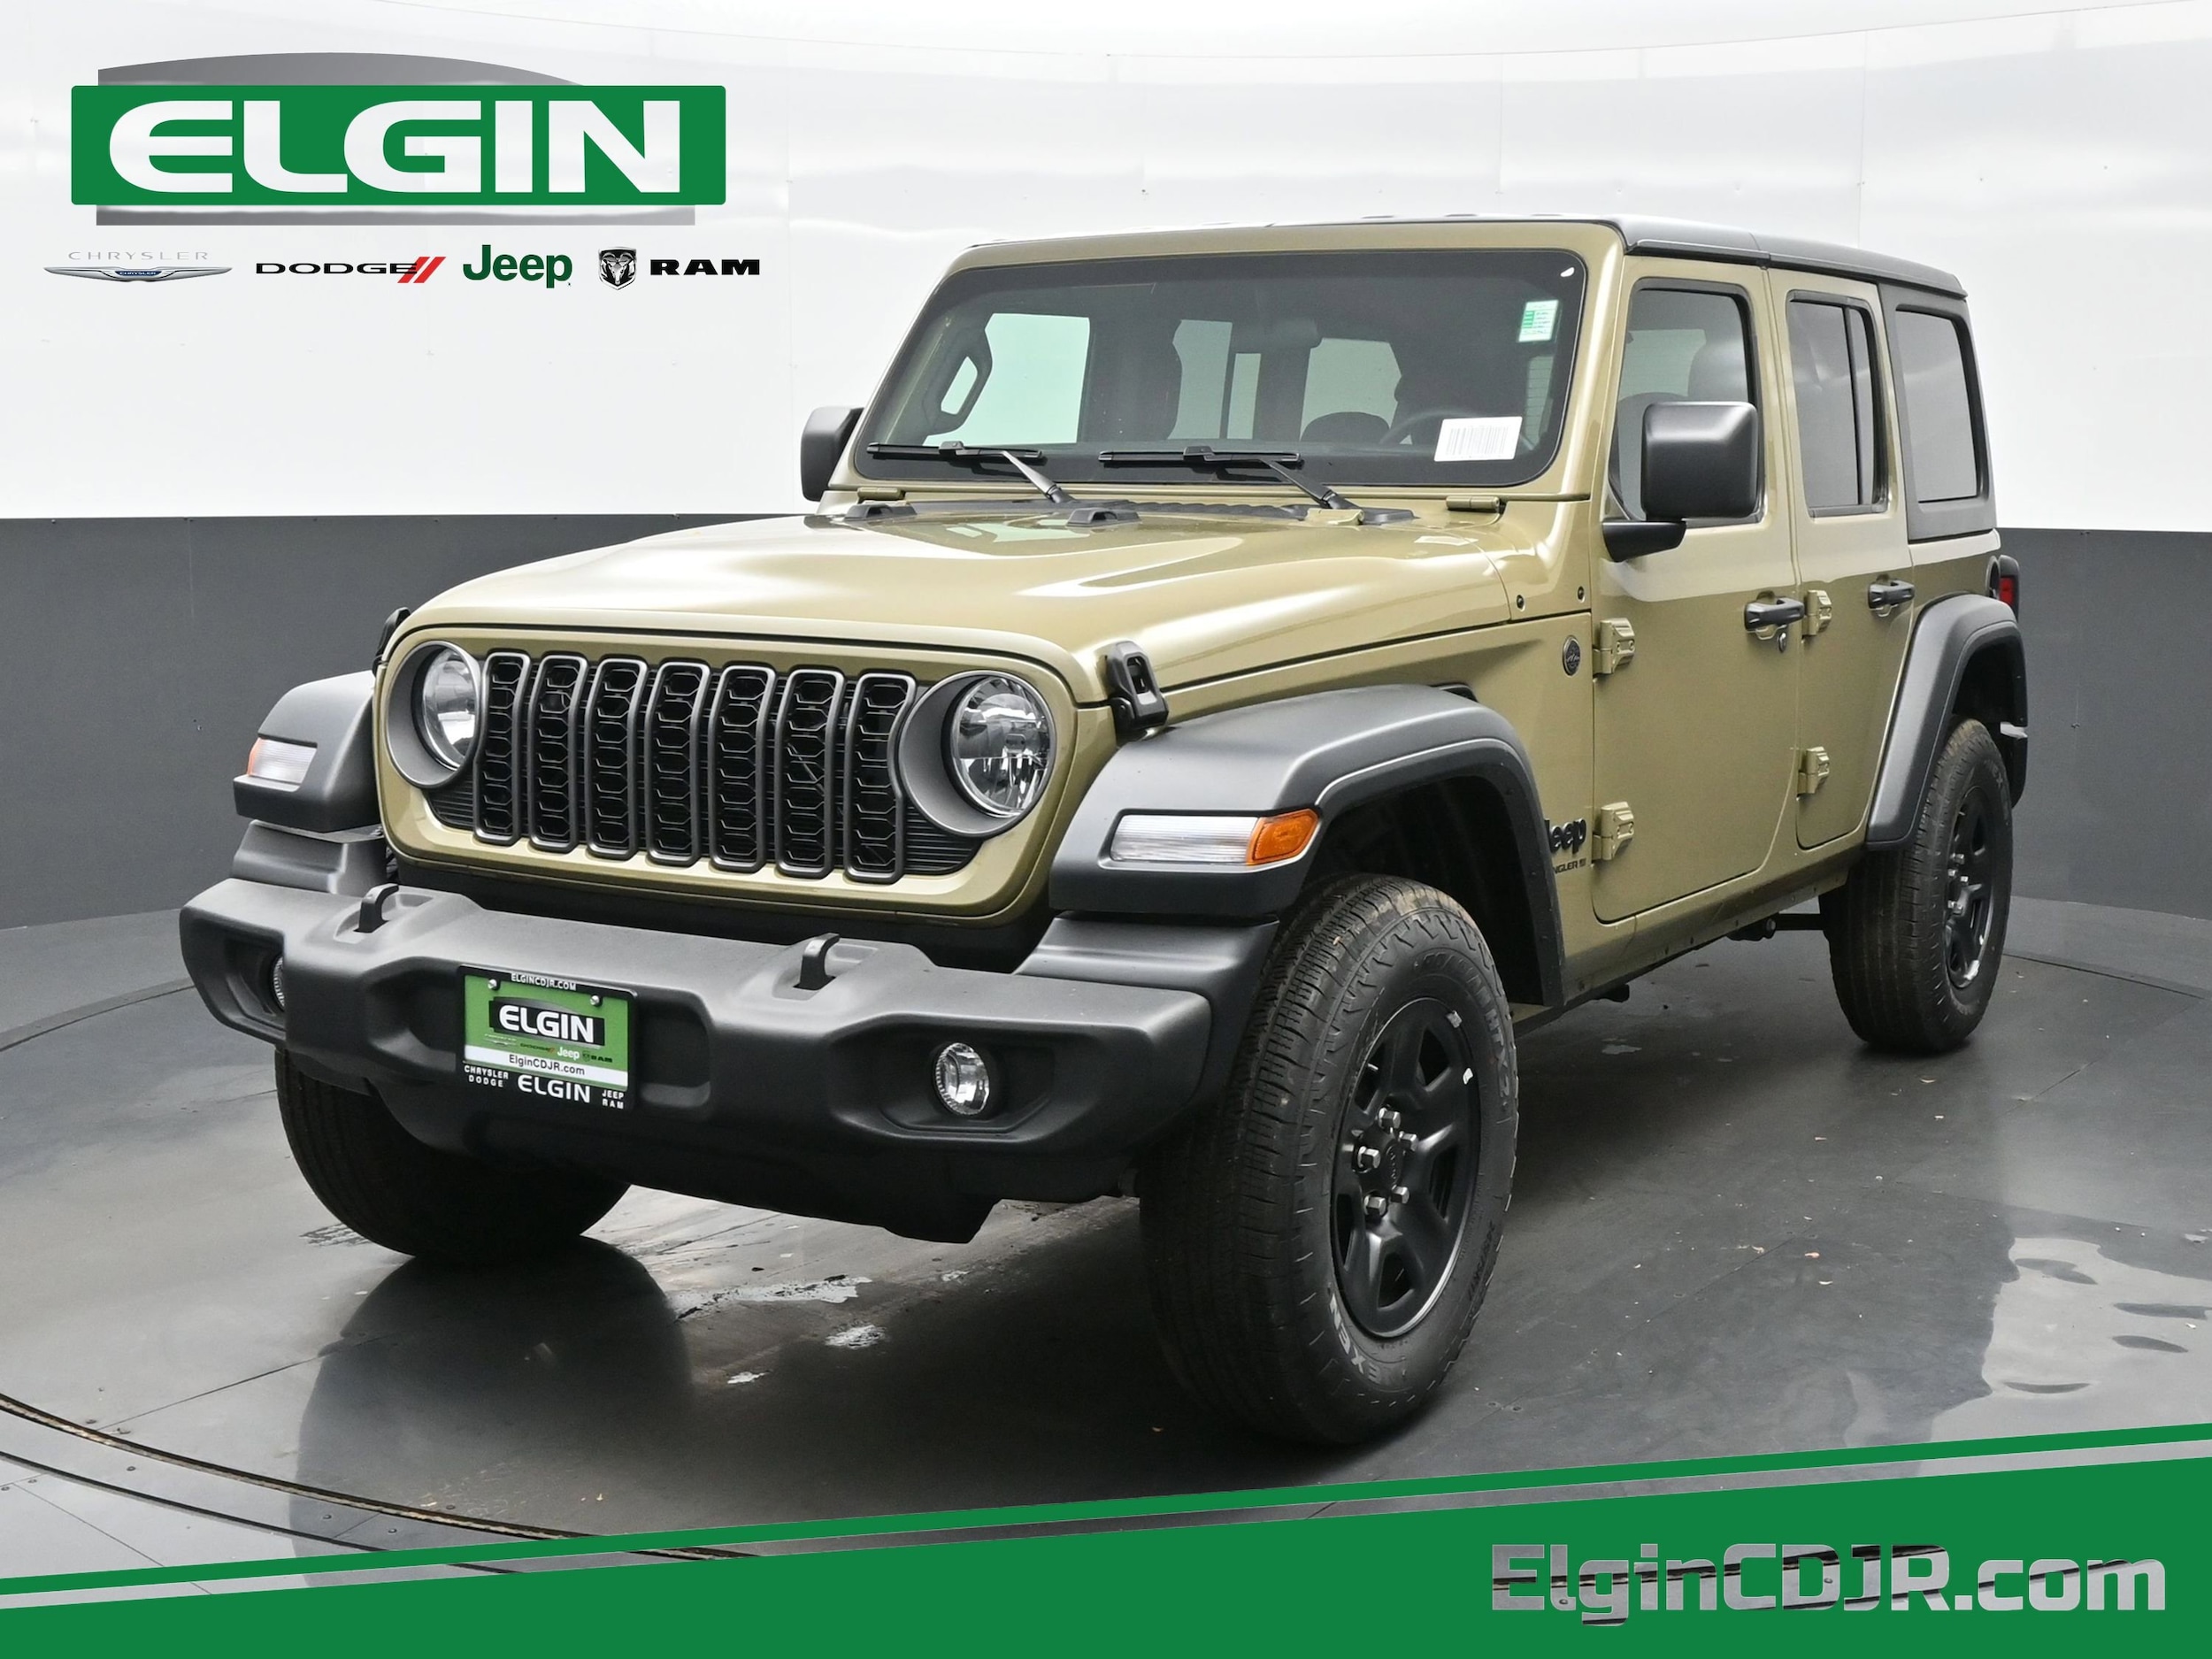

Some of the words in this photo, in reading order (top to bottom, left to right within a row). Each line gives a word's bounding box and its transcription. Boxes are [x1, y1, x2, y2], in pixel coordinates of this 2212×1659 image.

[511, 972, 577, 991] ELGINCDJR.COM
[499, 1004, 594, 1043] ELGIN
[557, 1046, 580, 1060] Jeep
[464, 1064, 509, 1079] CHRYSLER
[509, 1054, 585, 1076] ElginCDJR.com
[468, 1075, 503, 1087] DODGE
[518, 1074, 590, 1103] ELGIN
[602, 1089, 624, 1100] JEEP
[602, 1099, 624, 1110] RAM
